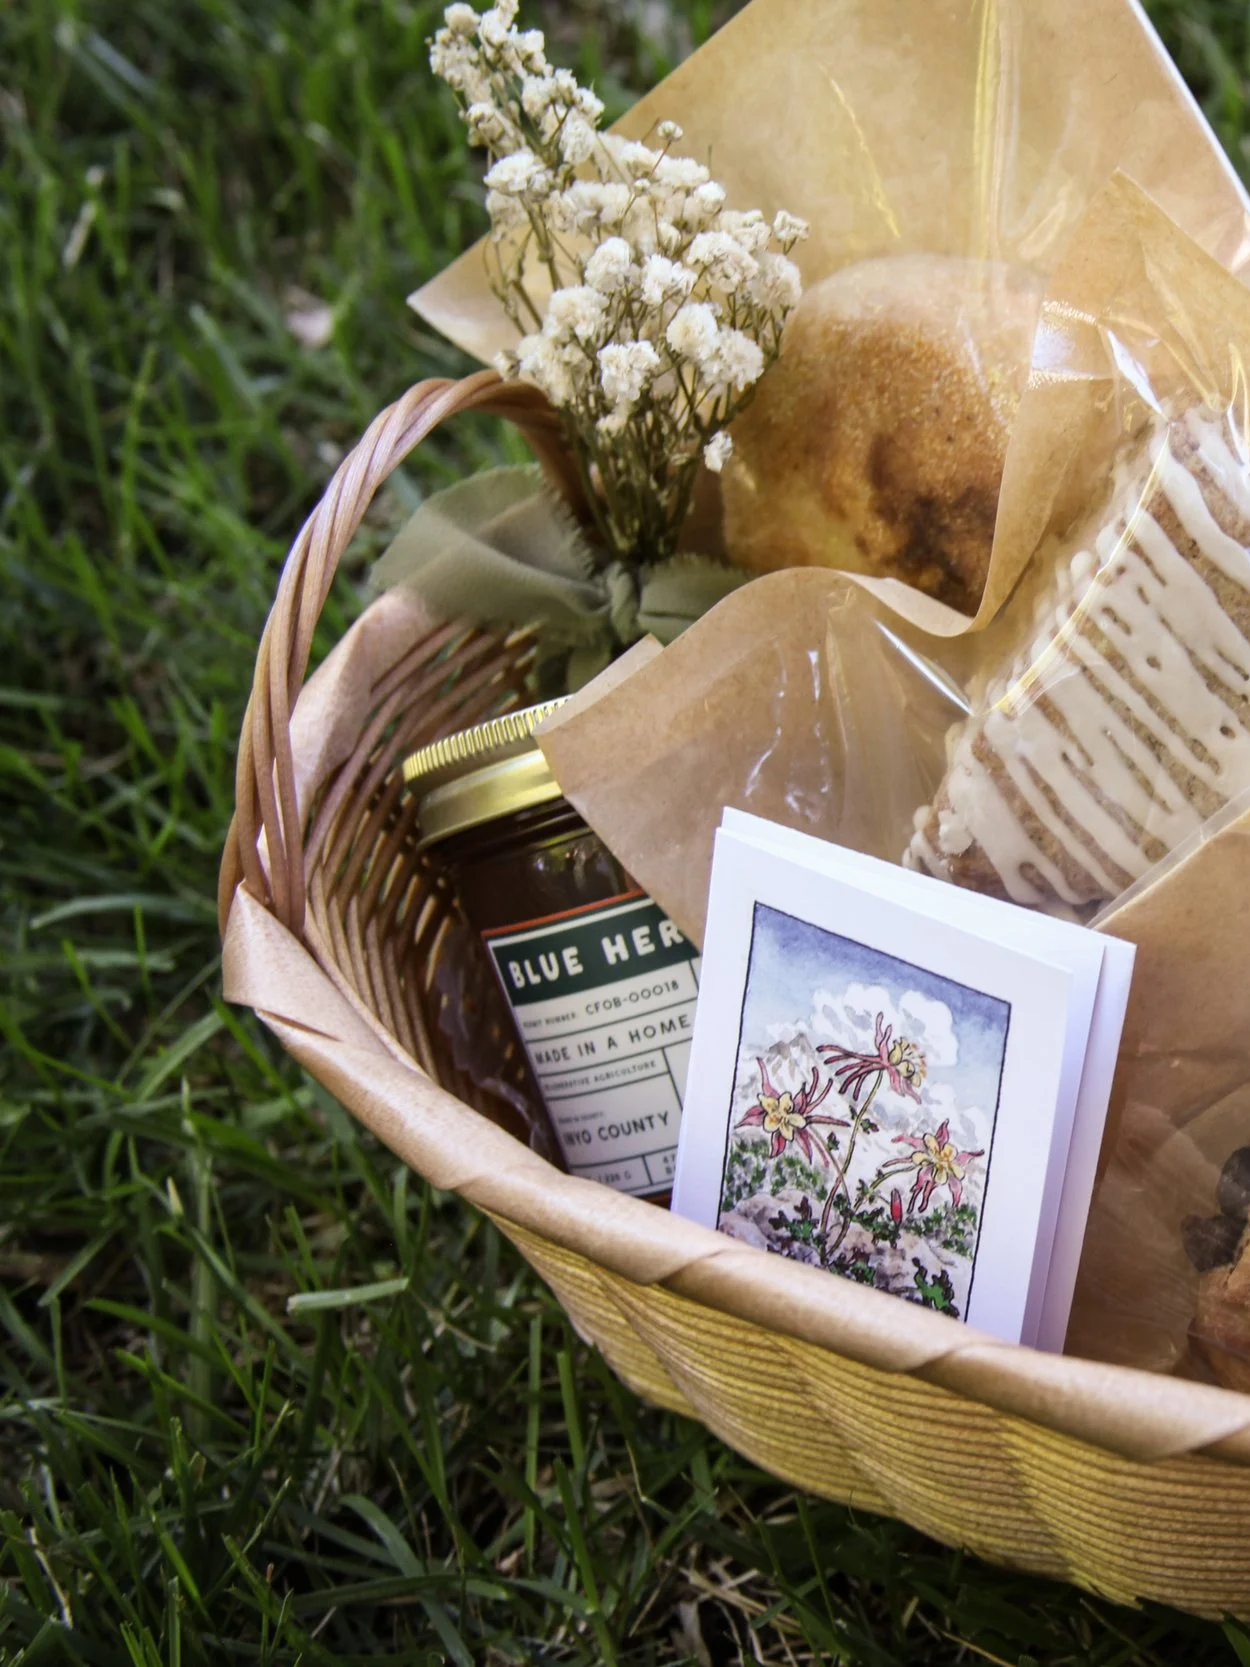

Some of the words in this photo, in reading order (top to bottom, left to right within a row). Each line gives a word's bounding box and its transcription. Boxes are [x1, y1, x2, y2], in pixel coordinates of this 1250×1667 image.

[507, 946, 584, 989] BLUE
[601, 919, 684, 966] HER
[585, 979, 680, 1015] CFOB-00018
[535, 1047, 570, 1065] MADE
[577, 1041, 597, 1057] IN
[607, 1036, 618, 1049] A
[628, 1014, 691, 1044] HOME
[597, 1110, 669, 1141] COUNTY
